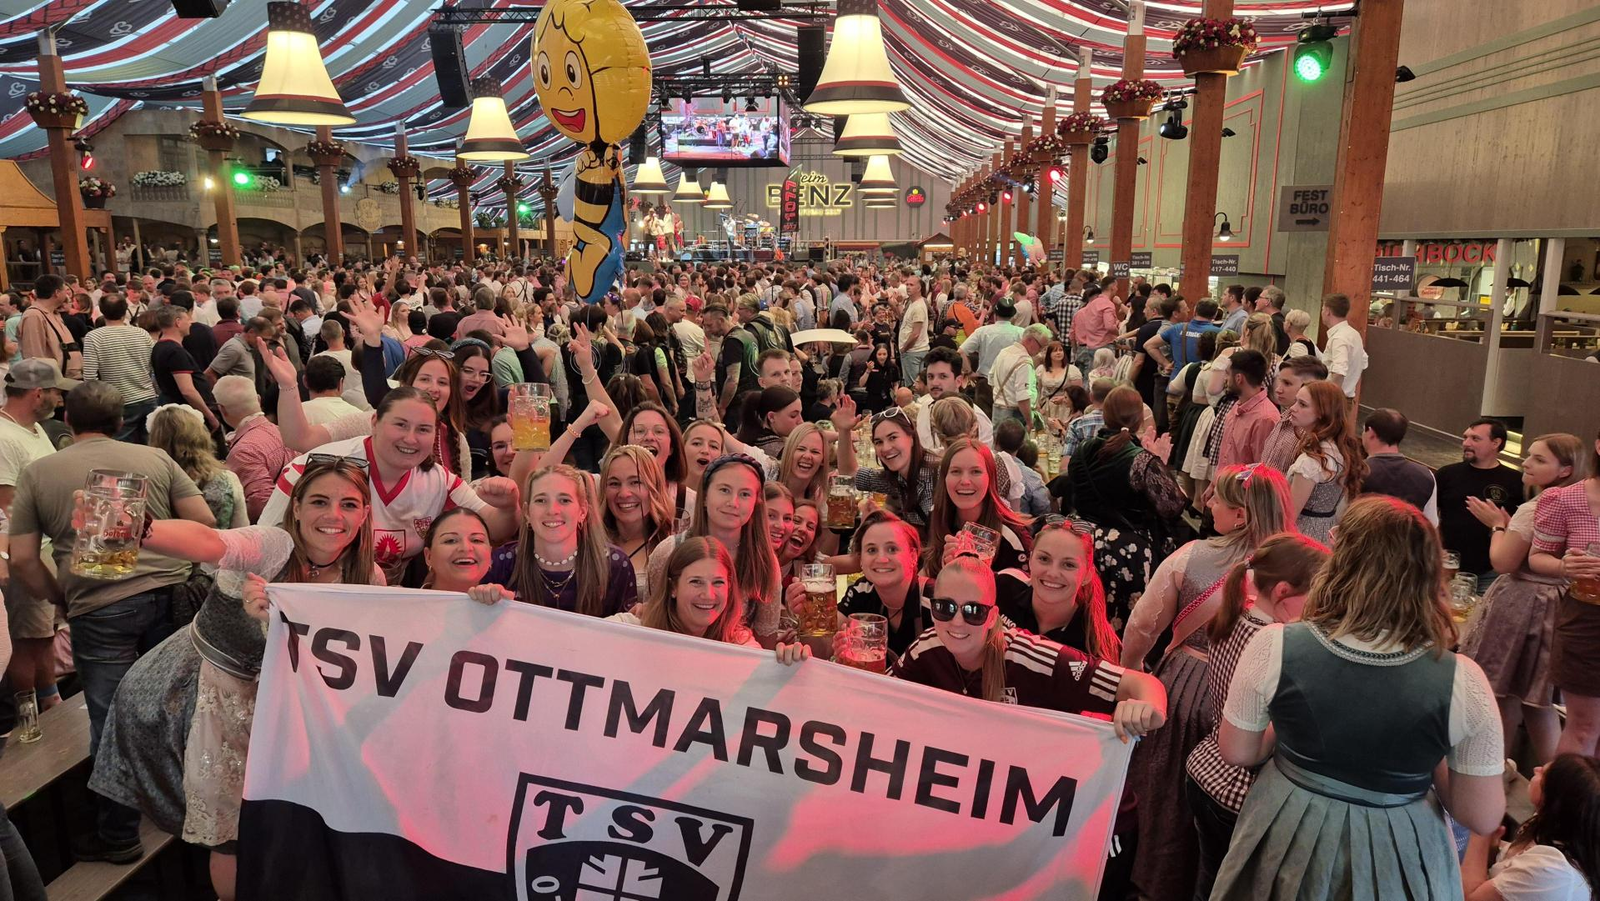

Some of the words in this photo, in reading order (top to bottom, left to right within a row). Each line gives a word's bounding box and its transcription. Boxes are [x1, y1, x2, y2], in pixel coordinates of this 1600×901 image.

[1294, 190, 1328, 201] FEST
[1290, 201, 1329, 214] BÜRO
[1113, 263, 1129, 271] WC
[1374, 263, 1411, 272] Tisch-Nr.
[1373, 274, 1410, 283] 441-464
[280, 611, 424, 698] TSV
[444, 650, 1078, 837] OTTMARSHEIM
[533, 790, 734, 868] TSV
